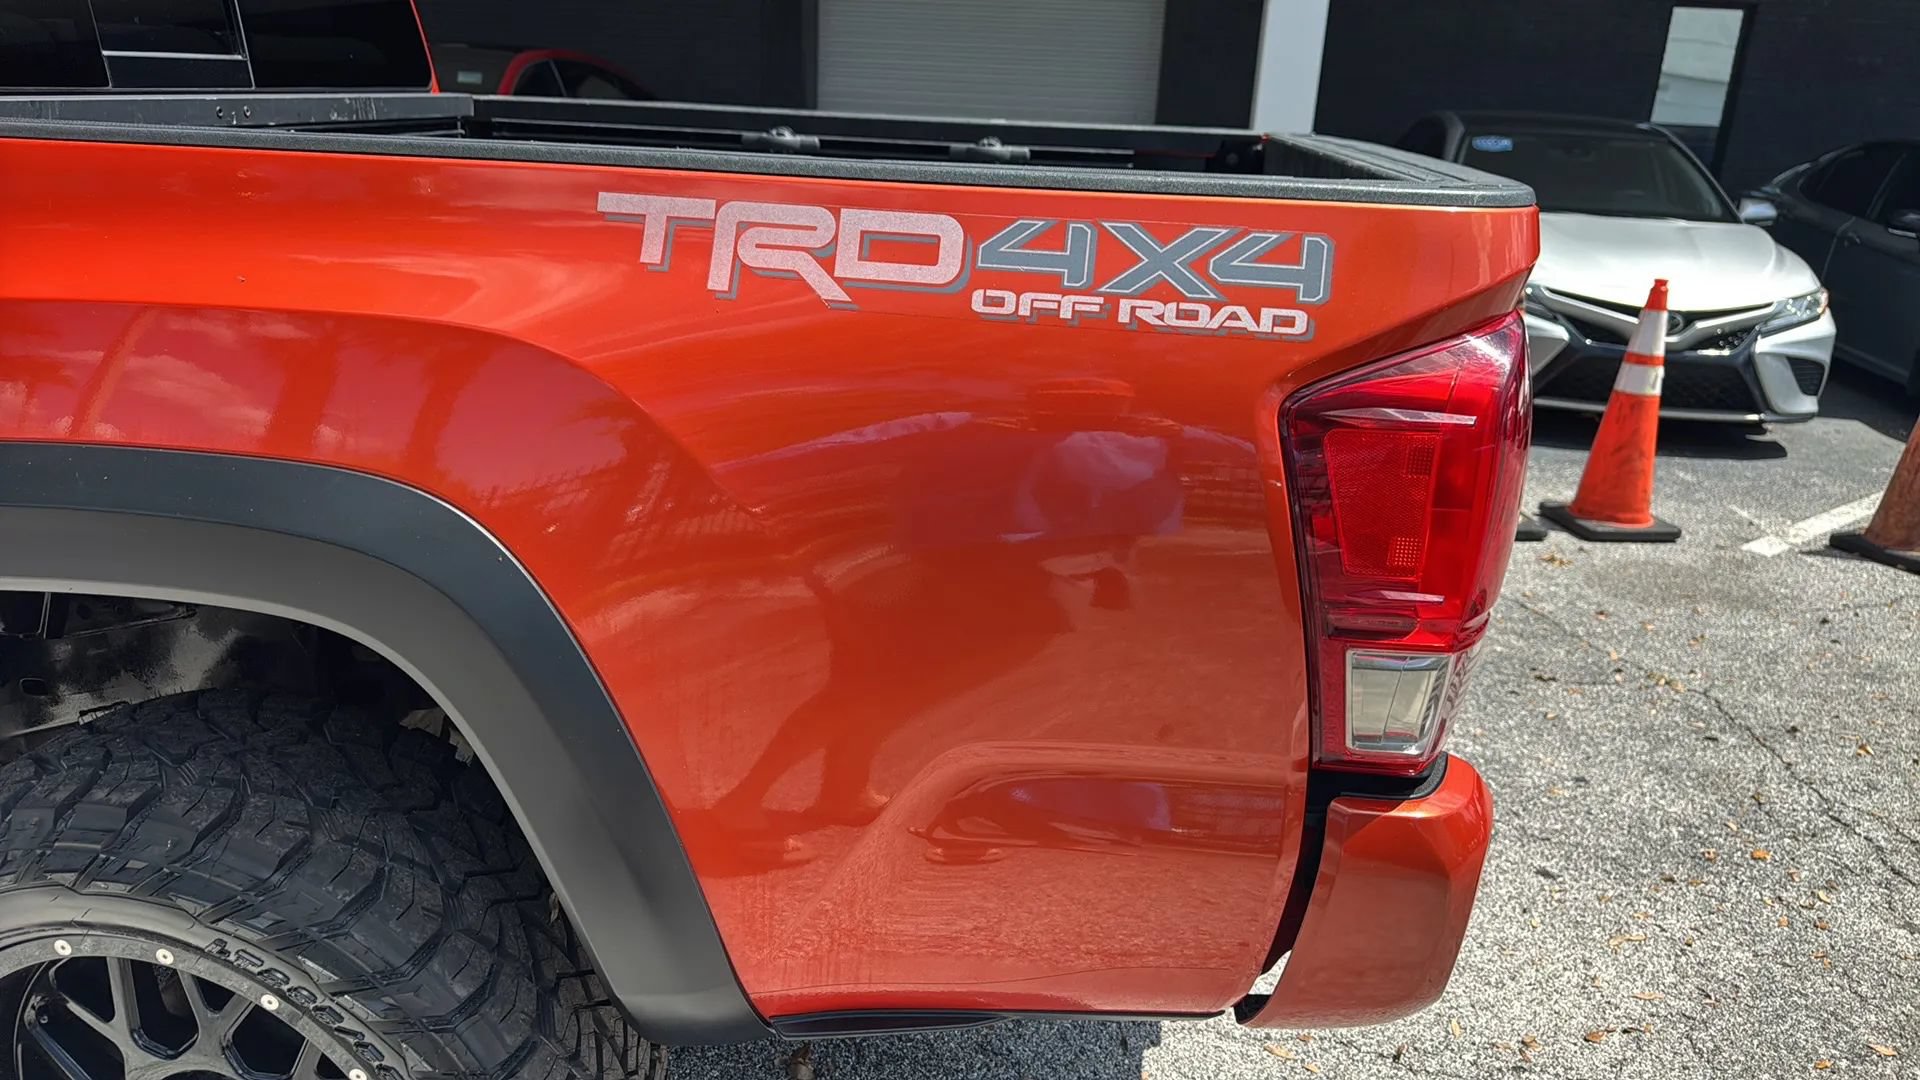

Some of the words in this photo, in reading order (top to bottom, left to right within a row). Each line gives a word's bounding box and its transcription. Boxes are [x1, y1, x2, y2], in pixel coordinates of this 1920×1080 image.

[597, 192, 969, 306] TRD
[976, 216, 1335, 304] 4X4
[971, 288, 1106, 324] OFF
[1117, 298, 1312, 338] ROAD
